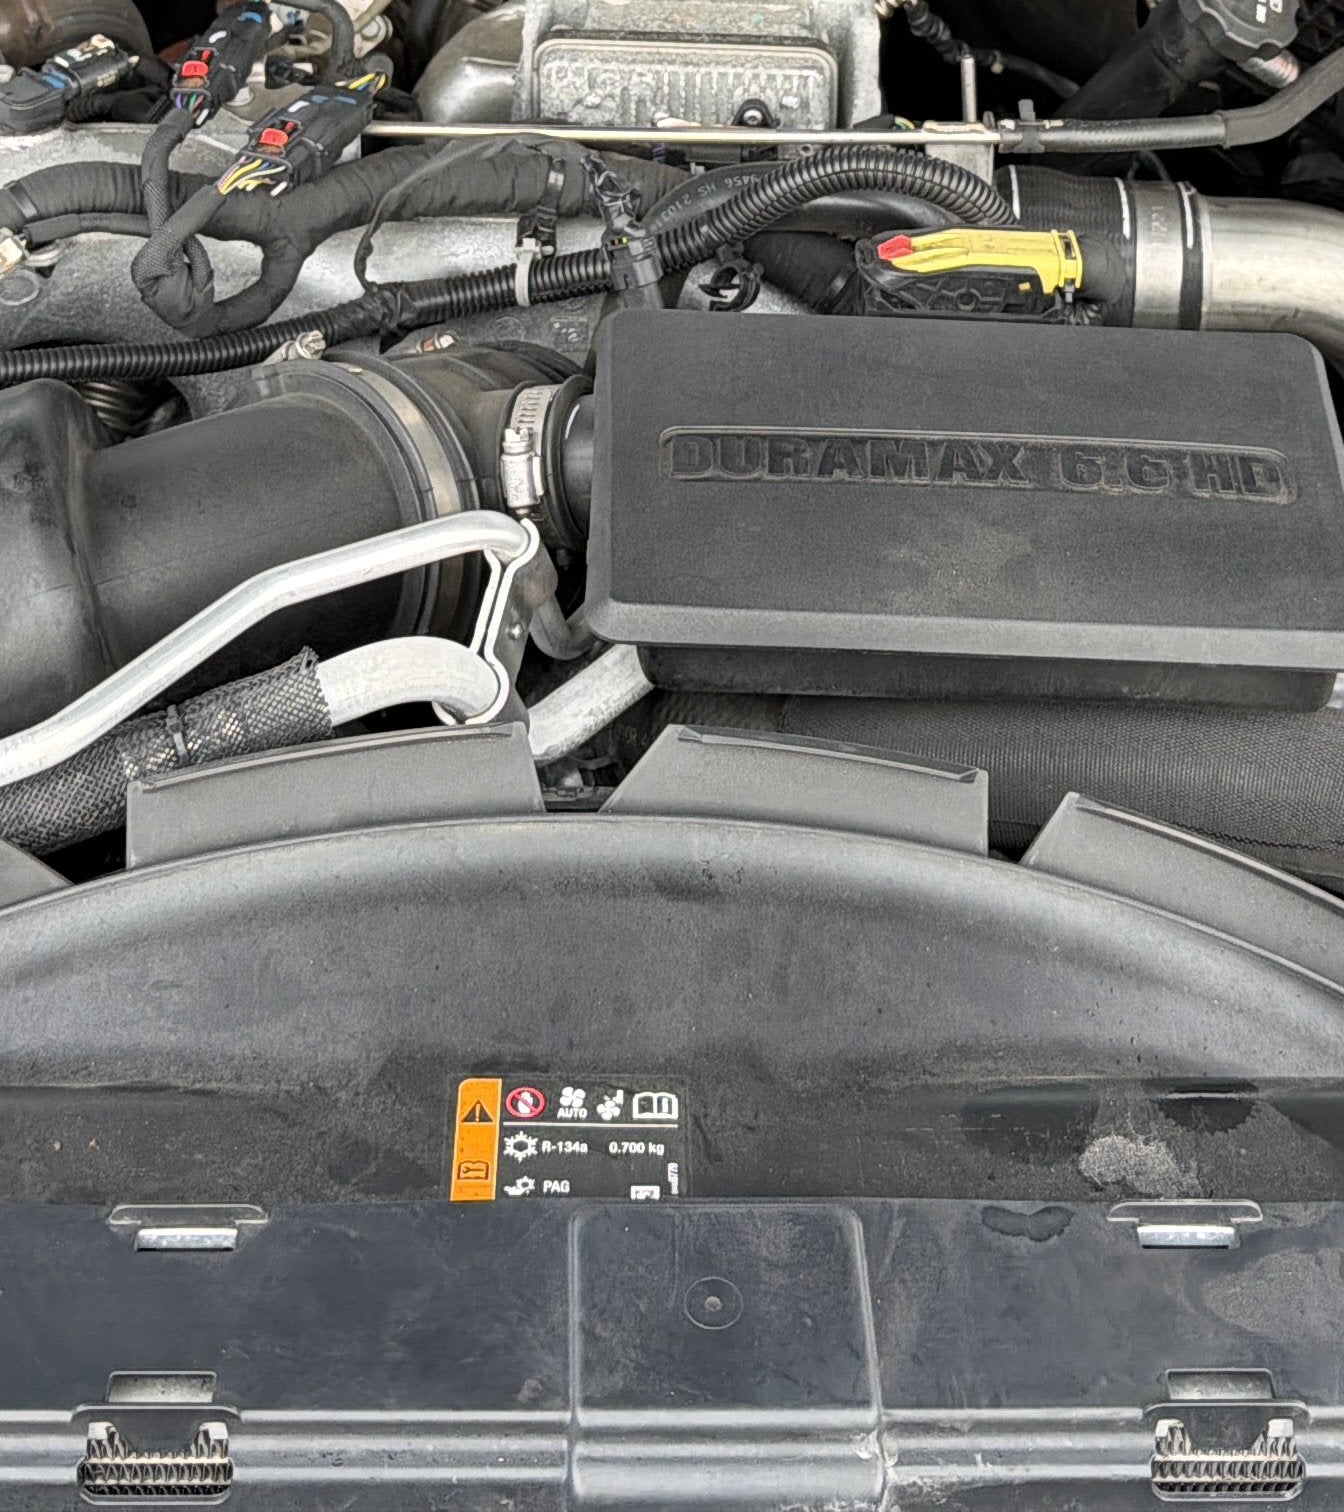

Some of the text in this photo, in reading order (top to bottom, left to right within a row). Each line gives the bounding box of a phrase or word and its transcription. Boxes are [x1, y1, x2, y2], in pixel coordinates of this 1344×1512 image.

[671, 433, 1284, 499] DURAMAX 6.6 HD
[557, 1107, 588, 1120] AUTO
[541, 1141, 665, 1156] R-134a 0.700 kg
[542, 1180, 570, 1193] PAG
